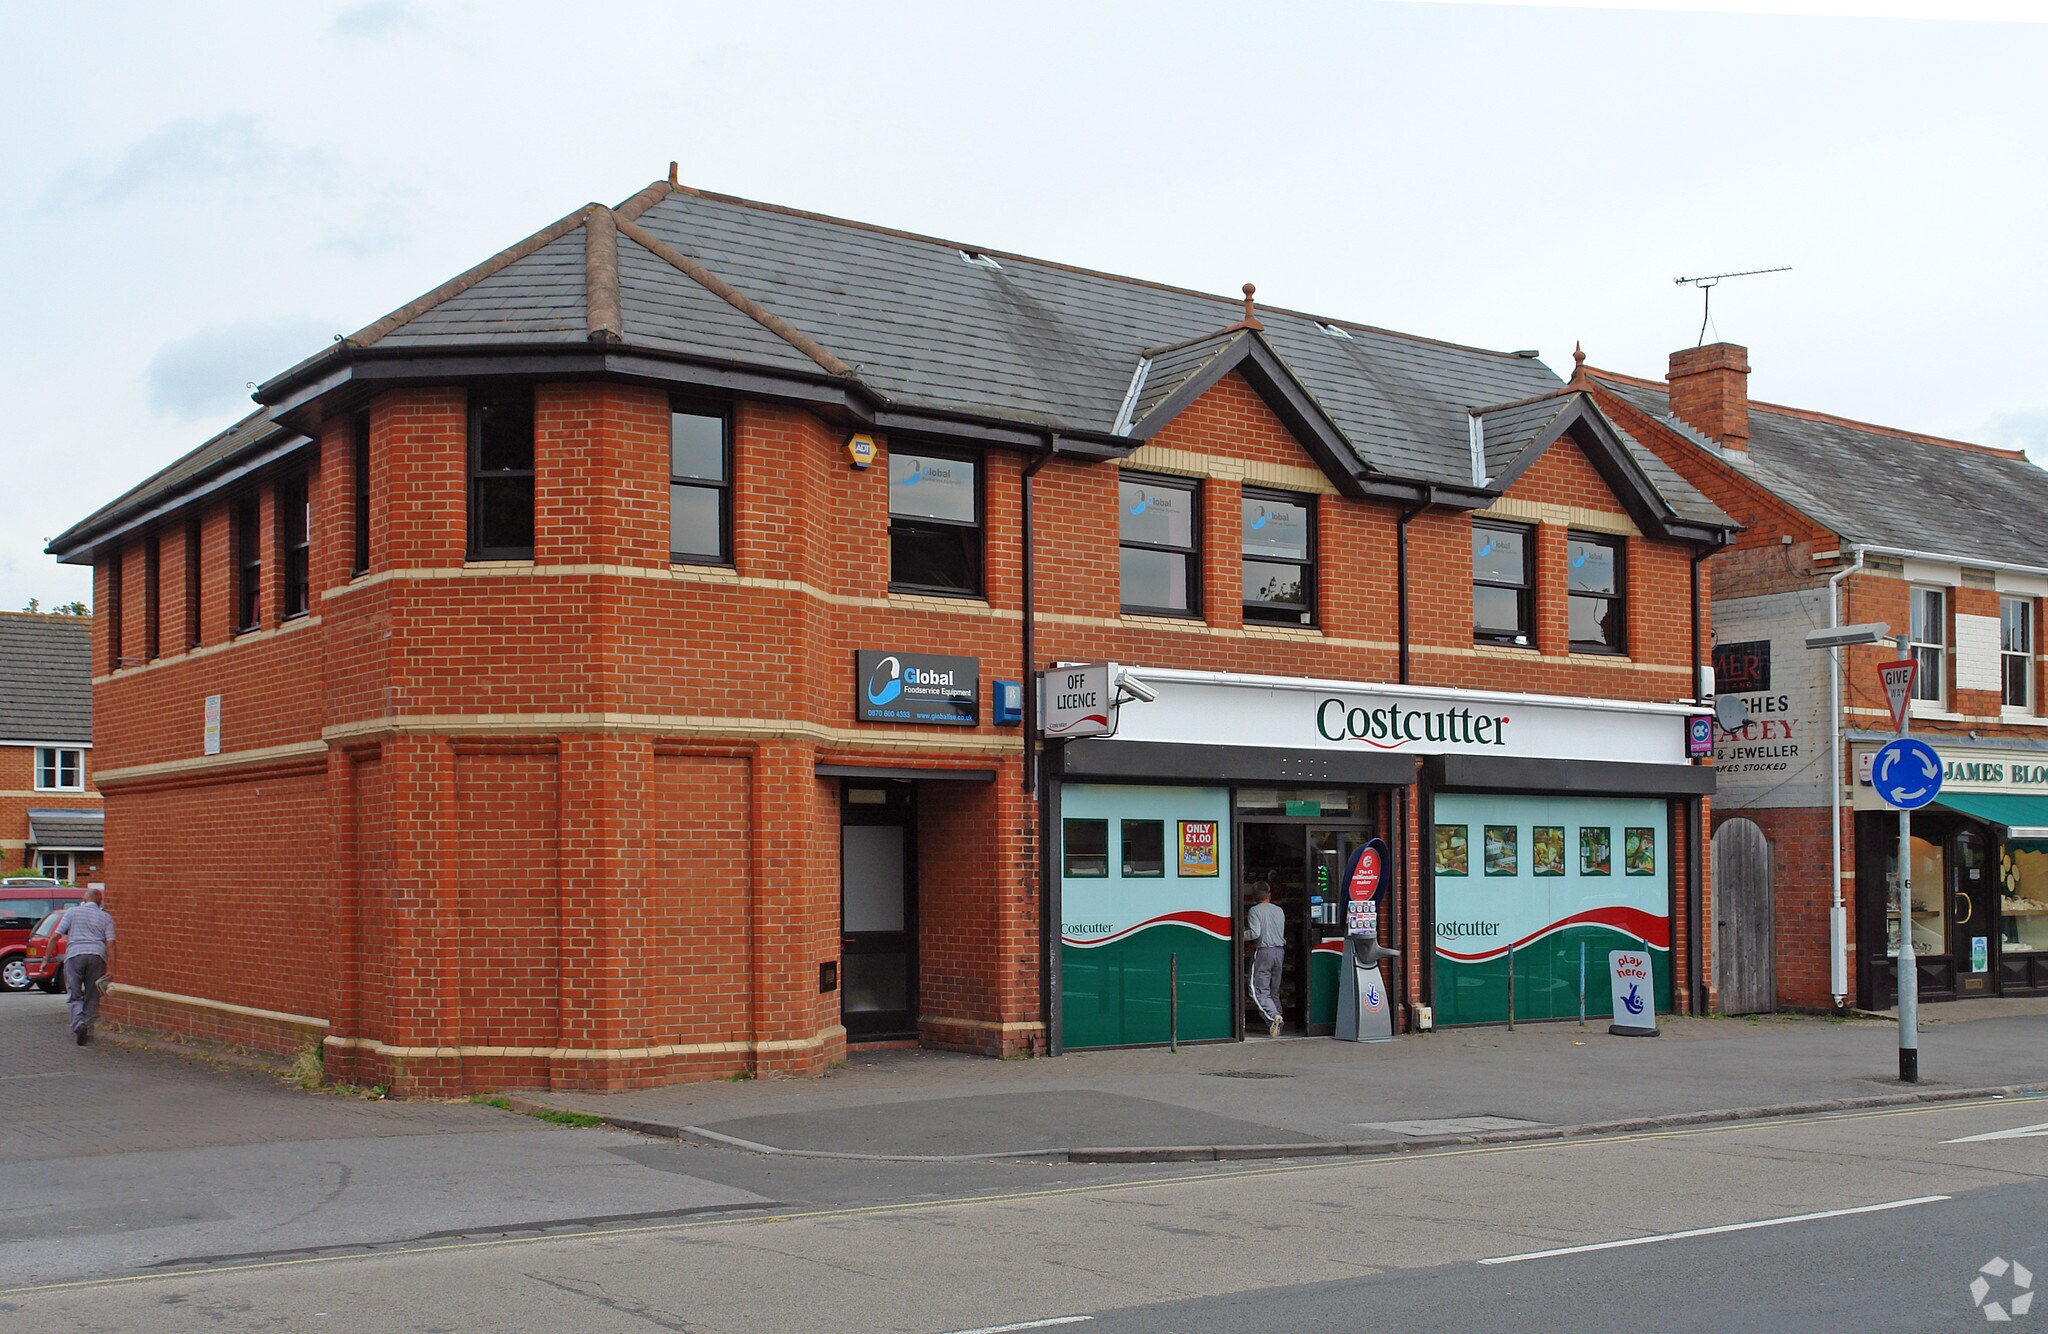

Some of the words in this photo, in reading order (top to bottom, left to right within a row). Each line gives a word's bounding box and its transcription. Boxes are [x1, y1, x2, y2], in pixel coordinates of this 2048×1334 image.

[856, 444, 870, 454] ADT
[922, 466, 951, 478] Global
[1147, 496, 1172, 508] Global
[1267, 512, 1289, 522] Global
[904, 667, 954, 686] Global
[1067, 674, 1085, 690] OFF
[1885, 669, 1908, 686] GIVE
[904, 686, 940, 695] Foodservice
[941, 688, 972, 698] Equipment
[1890, 688, 1906, 698] WAY
[1057, 692, 1097, 710] LICENCE
[867, 709, 882, 717] 0870
[883, 710, 895, 718] 600
[1317, 698, 1510, 746] Costcutter
[1714, 718, 1799, 743] ACEY
[1717, 749, 1724, 760] &
[1729, 745, 1799, 760] JEWELLER
[1742, 763, 1787, 772] STOCKED
[1944, 761, 2004, 782] JAMES
[1186, 824, 1210, 833] ONLY
[1185, 833, 1211, 843] £1.00
[1904, 879, 1911, 889] 6
[1061, 923, 1113, 935] Costcutter
[1437, 920, 1500, 936] ostcutter
[1617, 955, 1643, 967] play
[1616, 968, 1647, 980] here!
